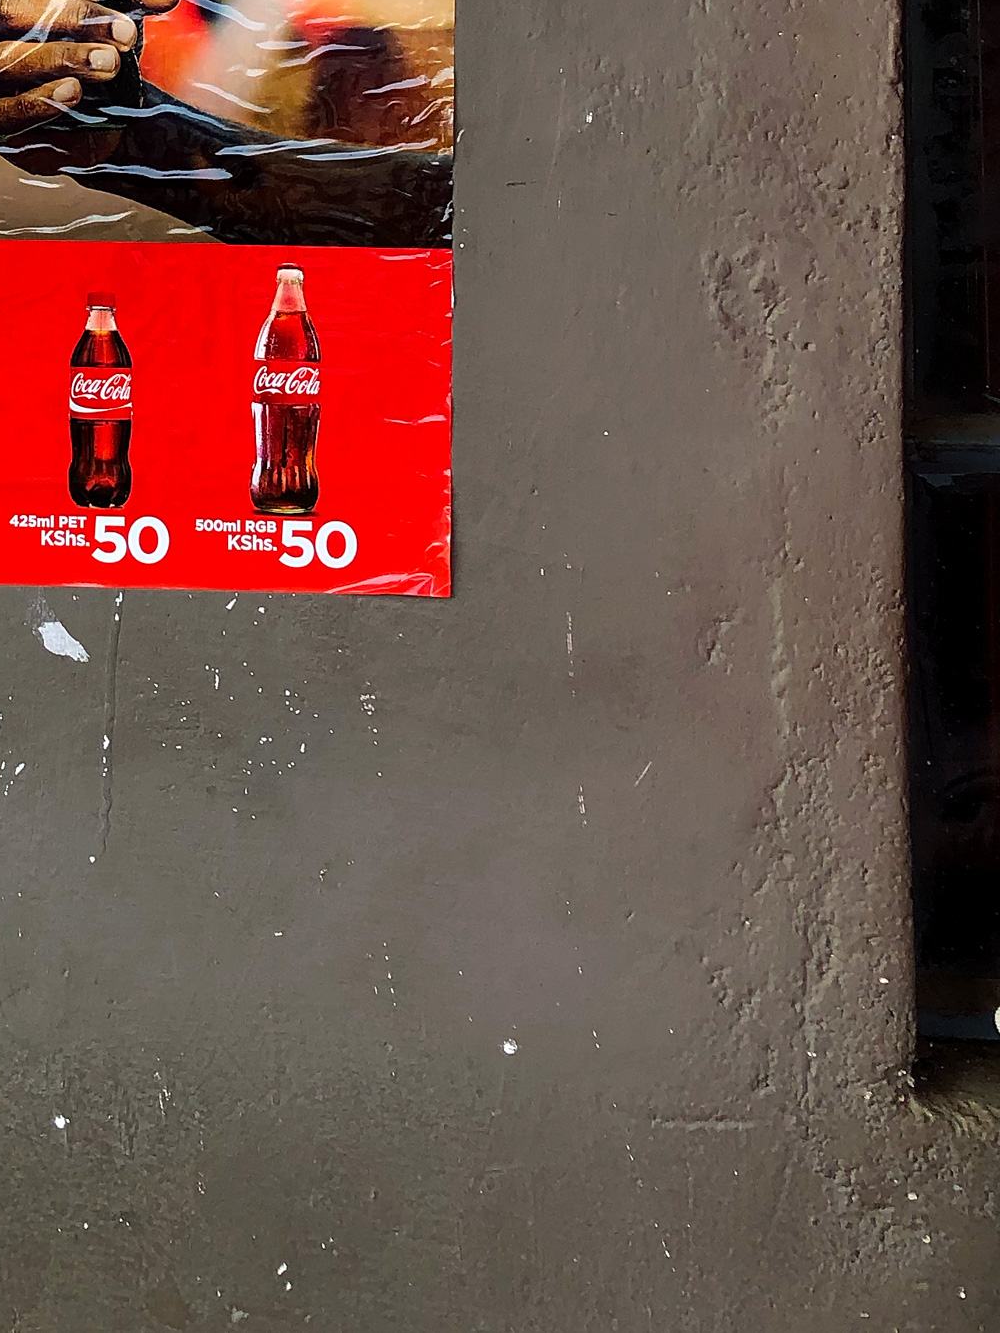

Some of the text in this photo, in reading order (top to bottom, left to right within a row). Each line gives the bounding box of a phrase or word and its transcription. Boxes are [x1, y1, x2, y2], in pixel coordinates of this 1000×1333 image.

[71, 372, 131, 401] Coca-Cola
[253, 365, 321, 396] Coca-Cola
[9, 514, 88, 529] 425ml PET
[194, 518, 277, 534] 500ml RGB
[40, 515, 170, 564] KShs. 50
[227, 519, 358, 569] KShs. 50
